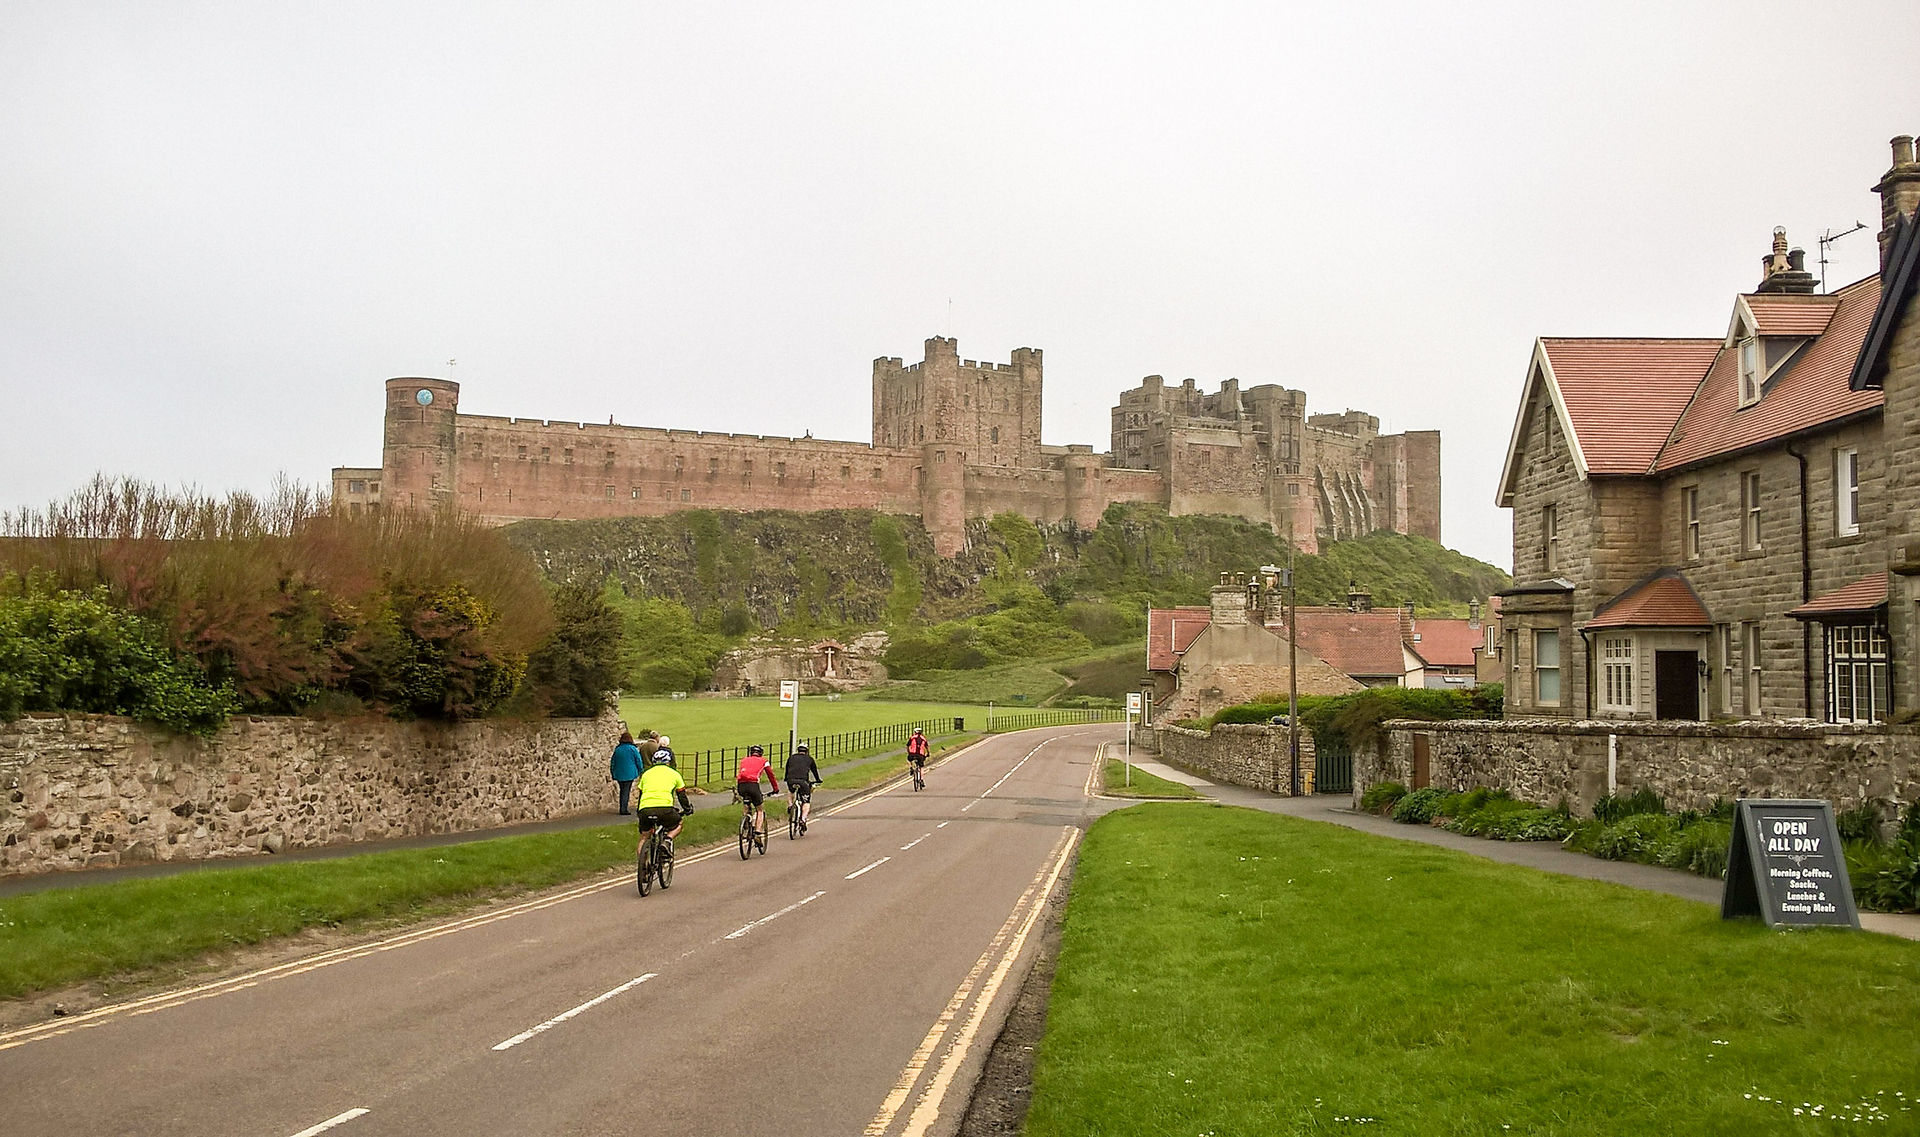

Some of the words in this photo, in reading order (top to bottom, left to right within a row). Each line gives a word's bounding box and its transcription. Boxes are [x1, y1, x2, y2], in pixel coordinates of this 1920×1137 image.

[1773, 821, 1808, 835] OPEN
[1768, 838, 1791, 852] ALL
[1794, 838, 1820, 852] DAY
[1770, 868, 1801, 879] Morning
[1802, 868, 1833, 879] Coffees,
[1789, 880, 1818, 890] Snacks,
[1787, 891, 1817, 901] Lunches
[1818, 891, 1826, 901] &
[1782, 903, 1812, 914] Evening
[1813, 903, 1836, 913] Meals
